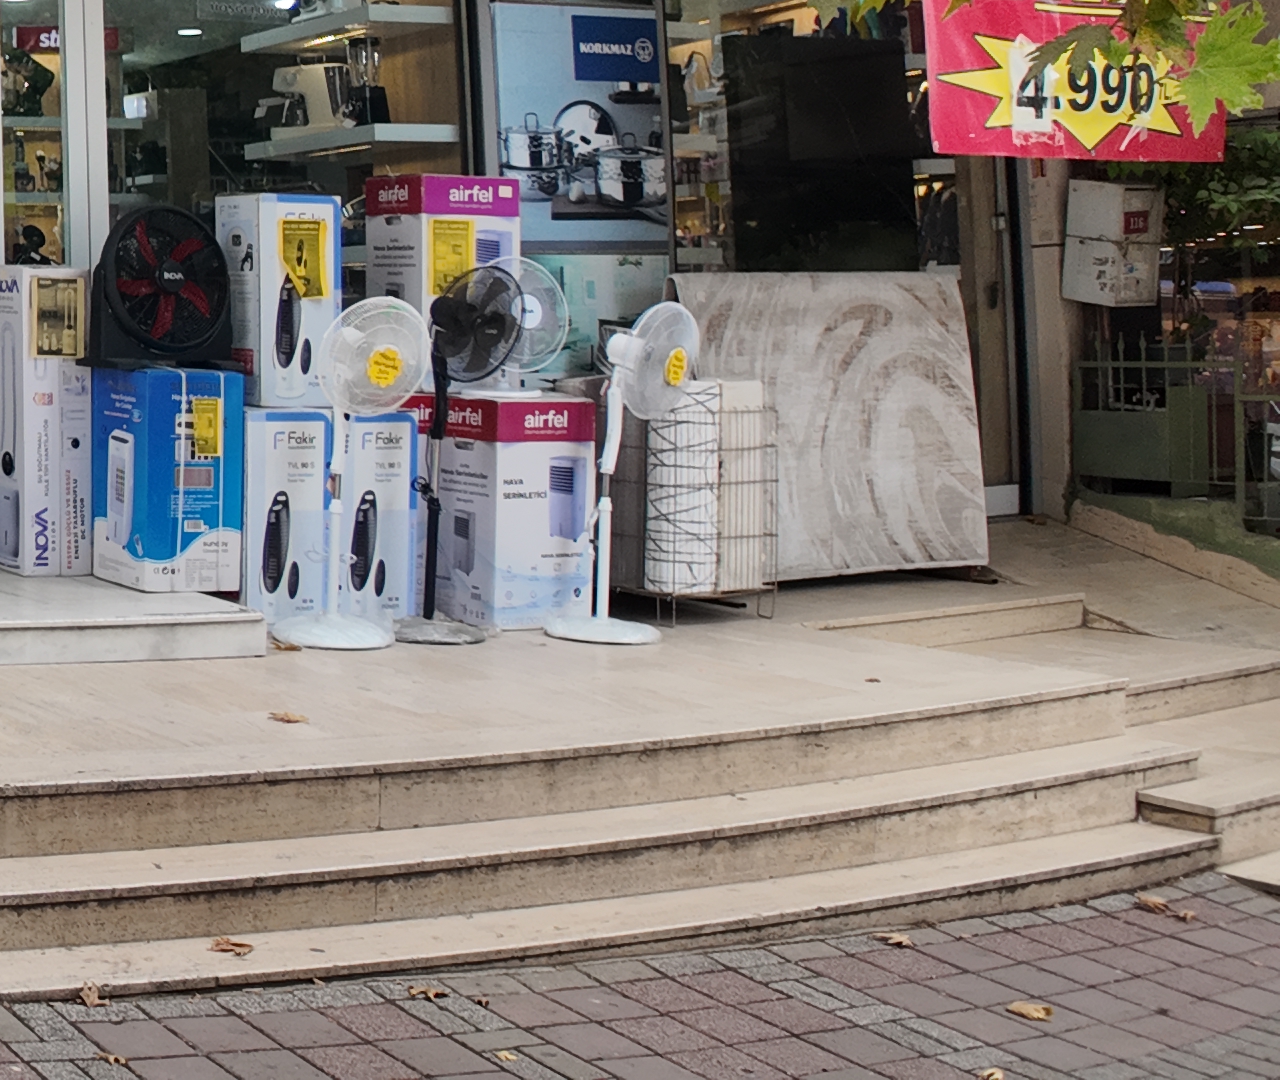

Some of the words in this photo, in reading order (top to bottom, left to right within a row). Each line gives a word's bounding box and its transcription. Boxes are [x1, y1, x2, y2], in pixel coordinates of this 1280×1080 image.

[579, 42, 634, 56] KORKMAZ
[1016, 61, 1155, 120] 4.990
[378, 184, 409, 203] airfel
[449, 184, 494, 203] airfel
[447, 407, 483, 426] airfel
[524, 410, 568, 428] airfel
[287, 431, 316, 445] Fakir
[375, 432, 403, 445] Fakir
[66, 497, 72, 509] VE
[503, 489, 547, 500] SERİNLETİCİ
[65, 510, 73, 538] GÜÇLÜ
